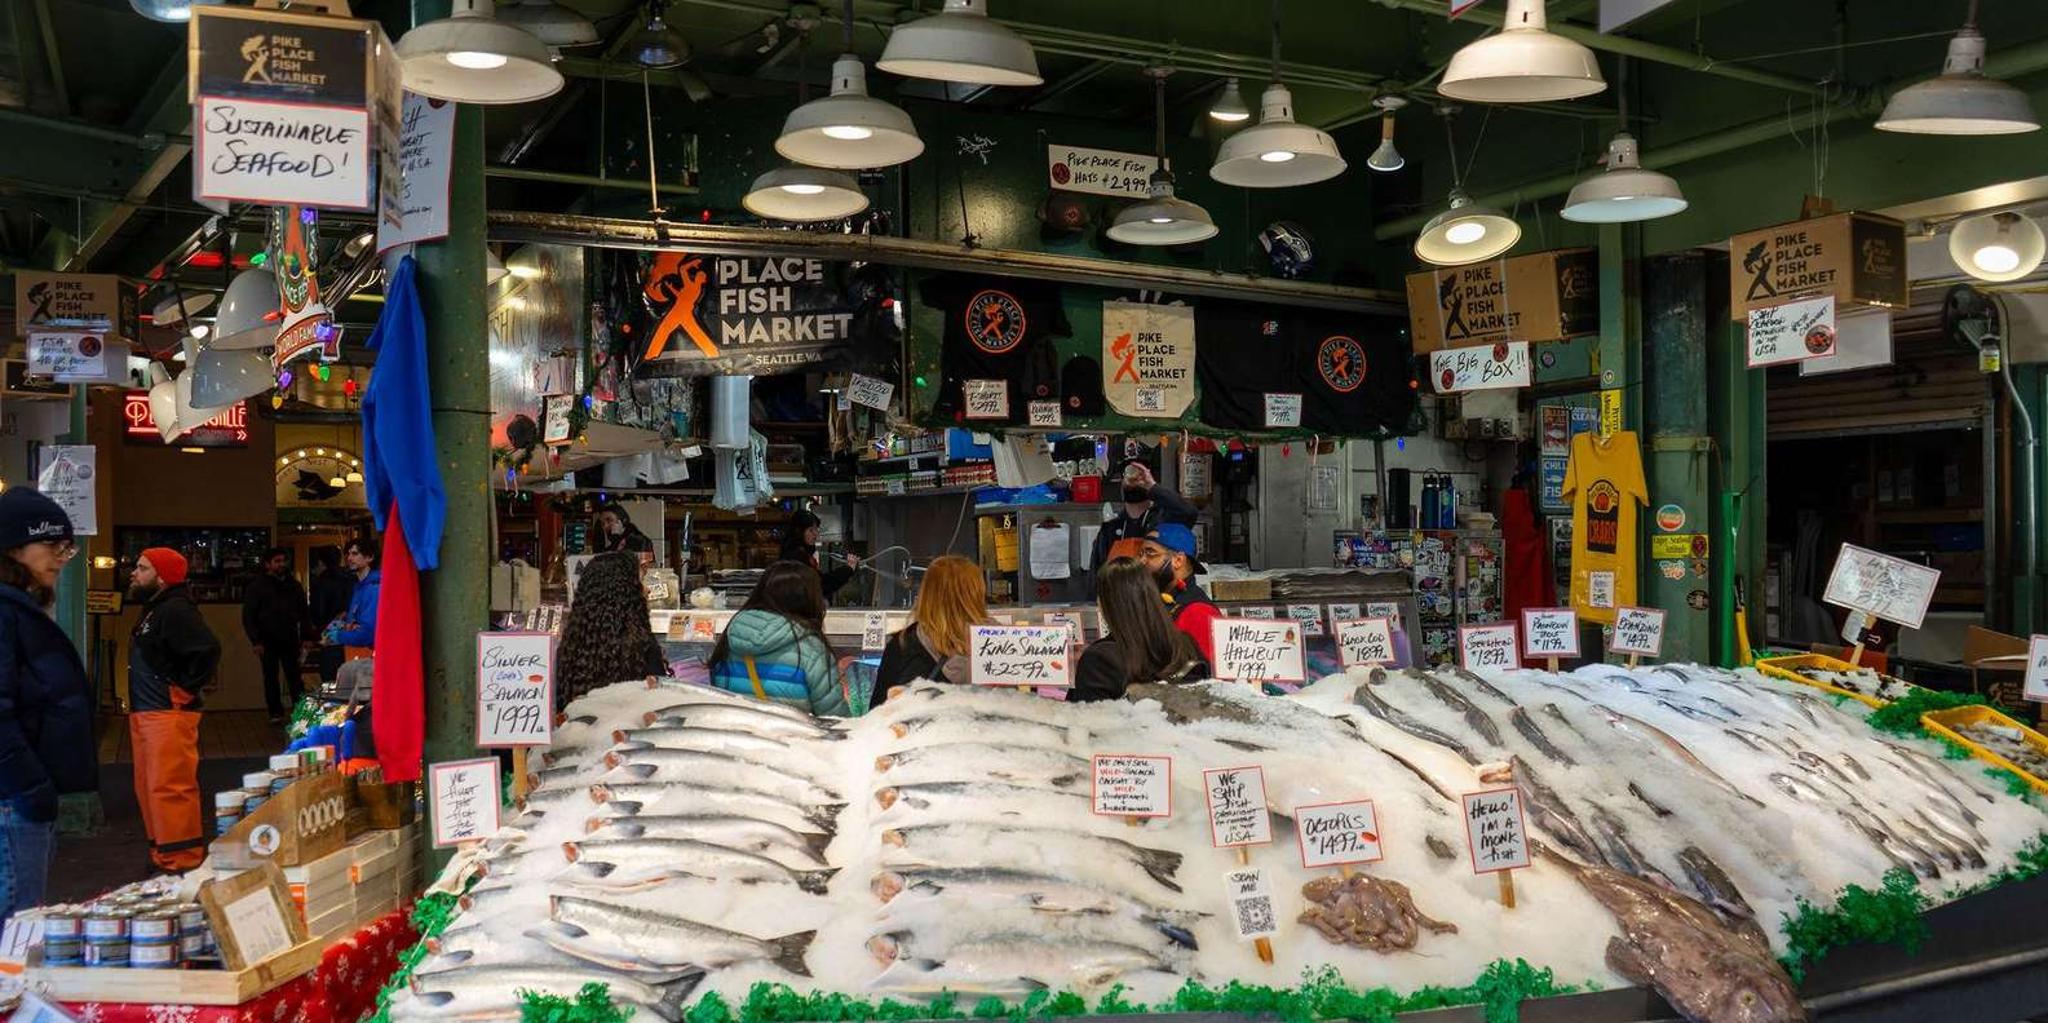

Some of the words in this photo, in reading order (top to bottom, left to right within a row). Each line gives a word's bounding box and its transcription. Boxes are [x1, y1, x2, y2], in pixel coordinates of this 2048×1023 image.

[272, 35, 301, 47] PIKE
[272, 47, 316, 61] PLACE
[272, 60, 300, 71] FISH
[271, 70, 327, 85] MARKET
[205, 105, 361, 145] SUSTAINABLE
[1123, 160, 1146, 173] FISH
[1074, 172, 1098, 184] HATS
[1776, 232, 1807, 248] PIKE
[1776, 244, 1822, 262] PLACE
[720, 258, 823, 285] PLACE
[1464, 267, 1492, 282] PIKE
[1776, 261, 1807, 276] FISH
[56, 281, 82, 290] PIKE
[1776, 269, 1837, 290] MARKET
[56, 291, 94, 301] PLACE
[1466, 281, 1504, 298] PLACE
[55, 302, 82, 311] FISH
[720, 286, 791, 315] FISH
[1467, 301, 1495, 315] FISH
[1469, 313, 1520, 330] MARKET
[721, 314, 854, 345] MARKET
[1138, 333, 1162, 342] PIKE
[1138, 345, 1175, 354] PLACE
[1139, 357, 1163, 366] FISH
[1435, 355, 1452, 373] THE
[1456, 352, 1479, 373] BIG
[1140, 369, 1186, 378] MARKET
[1544, 486, 1561, 497] FIS
[1229, 627, 1279, 643] WHOLE
[979, 637, 1017, 657] KING
[1019, 636, 1067, 657] SALMON
[1223, 643, 1291, 661] HALIBUT
[482, 646, 547, 669] SILVER
[481, 681, 547, 702] SALMON
[1218, 772, 1240, 787] WE
[1212, 784, 1245, 800] SHIP
[1214, 799, 1251, 809] FISH
[1470, 794, 1514, 819] HELLO!
[1305, 812, 1367, 835] OCTOPUS
[1506, 820, 1517, 829] A
[1224, 832, 1256, 844] USA
[1481, 831, 1520, 850] MONK
[1482, 847, 1518, 862] FISH
[1230, 869, 1260, 882] SCAN
[1241, 883, 1257, 893] ME
